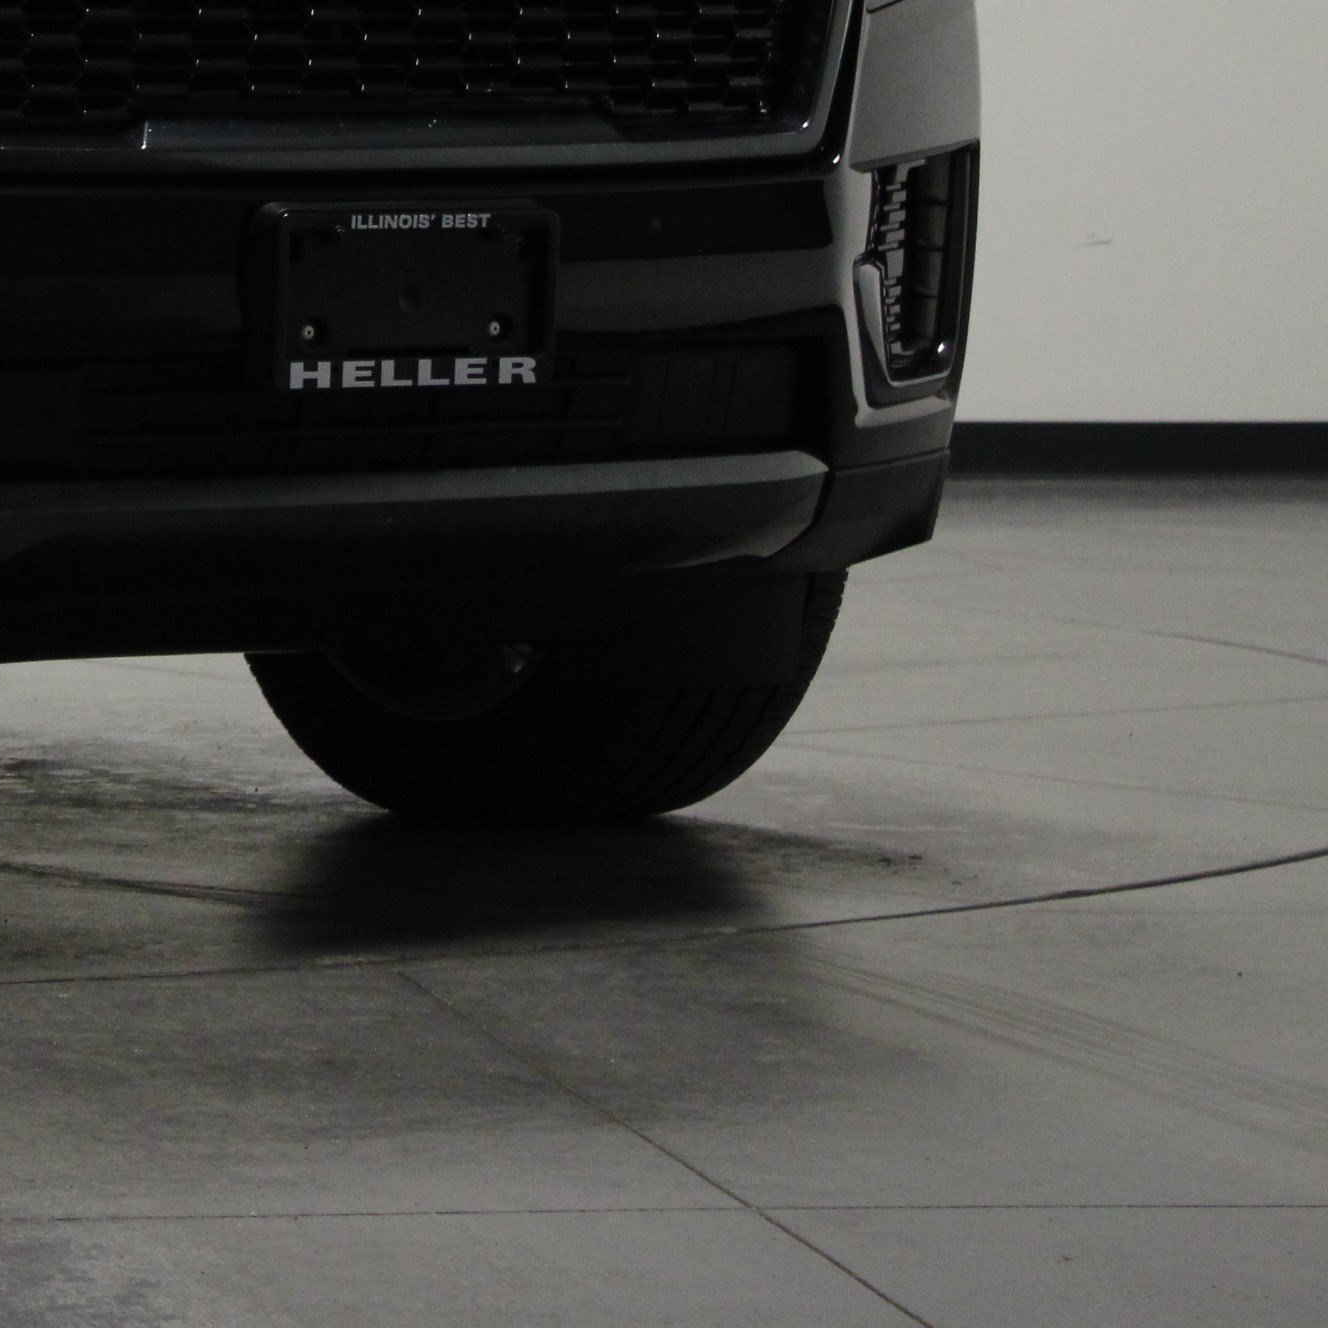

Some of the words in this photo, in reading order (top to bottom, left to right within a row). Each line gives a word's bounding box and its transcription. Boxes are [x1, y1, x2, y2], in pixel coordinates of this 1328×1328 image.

[350, 213, 436, 230] ILLINOIS'
[441, 213, 491, 229] BEST
[289, 356, 537, 390] HELLER
